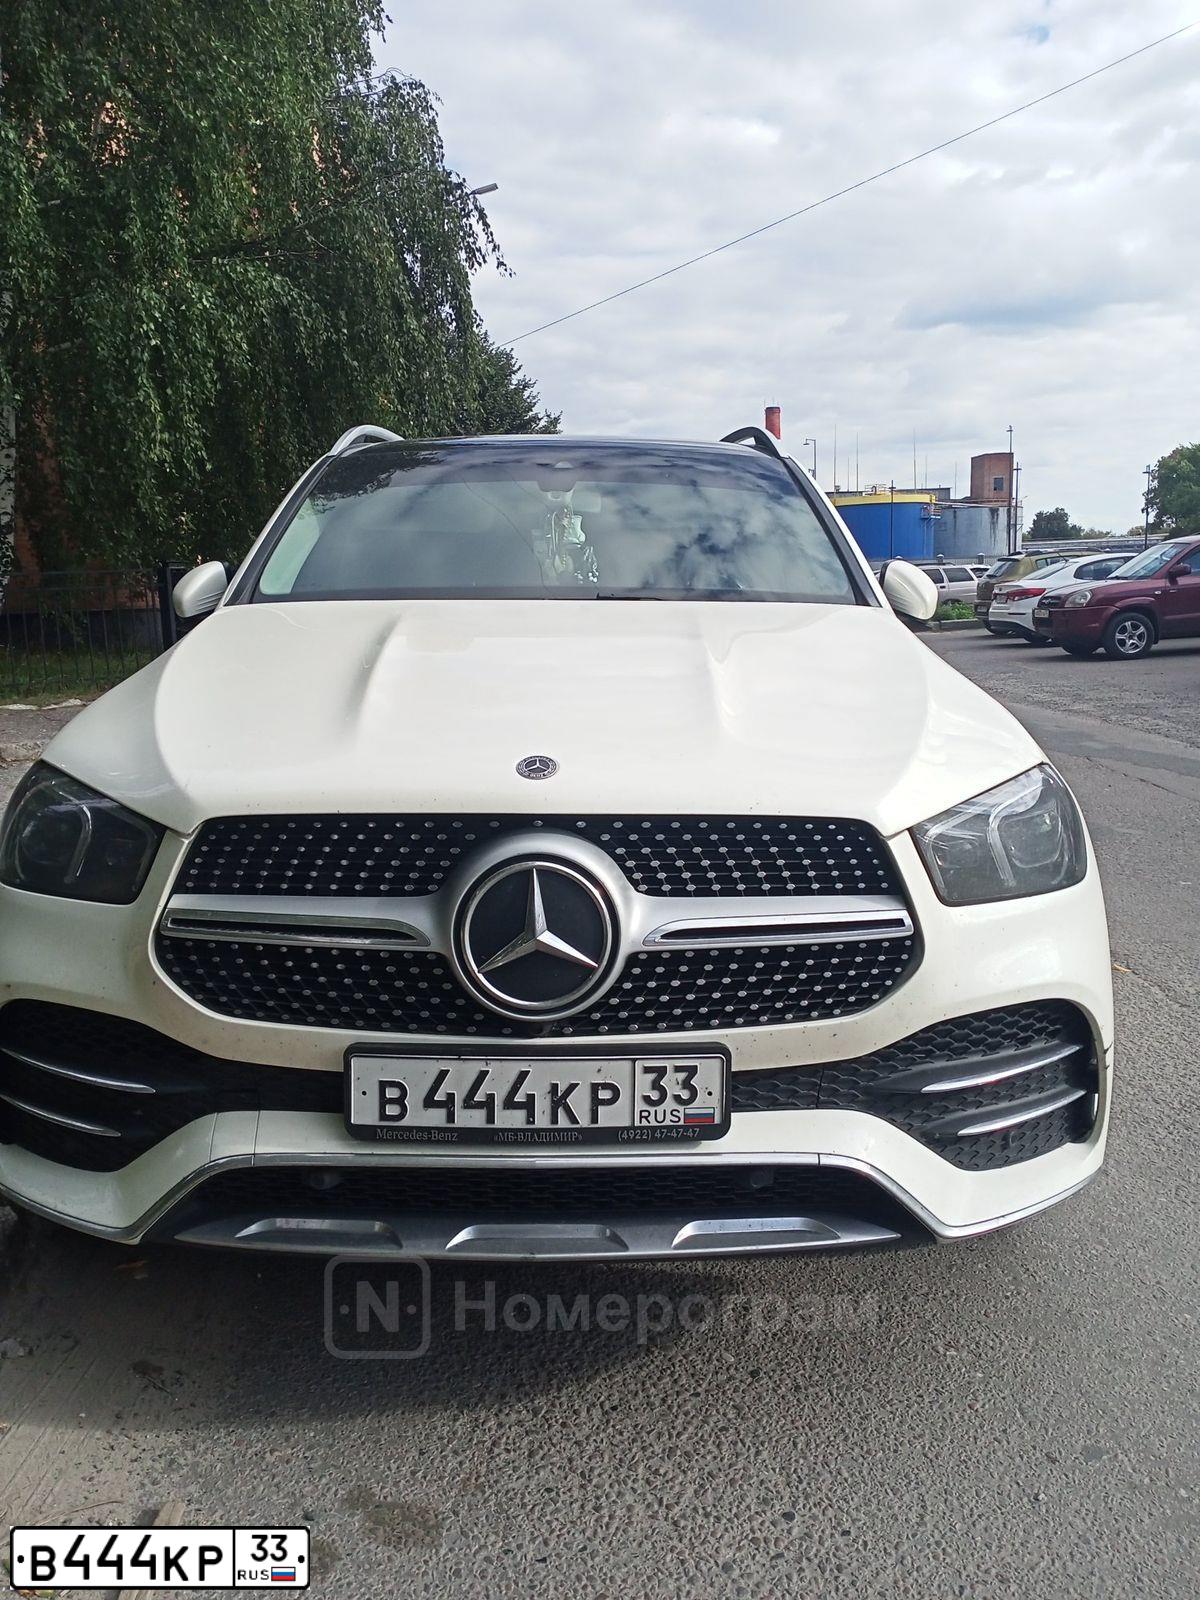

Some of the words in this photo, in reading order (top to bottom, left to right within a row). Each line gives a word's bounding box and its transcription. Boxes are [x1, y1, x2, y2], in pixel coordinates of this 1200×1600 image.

[642, 1064, 699, 1107] 33
[639, 1109, 682, 1124] RUS
[376, 1128, 458, 1142] Mercedes-Benz
[618, 1129, 652, 1141] (4922)
[654, 1127, 700, 1140] 47-47-47
